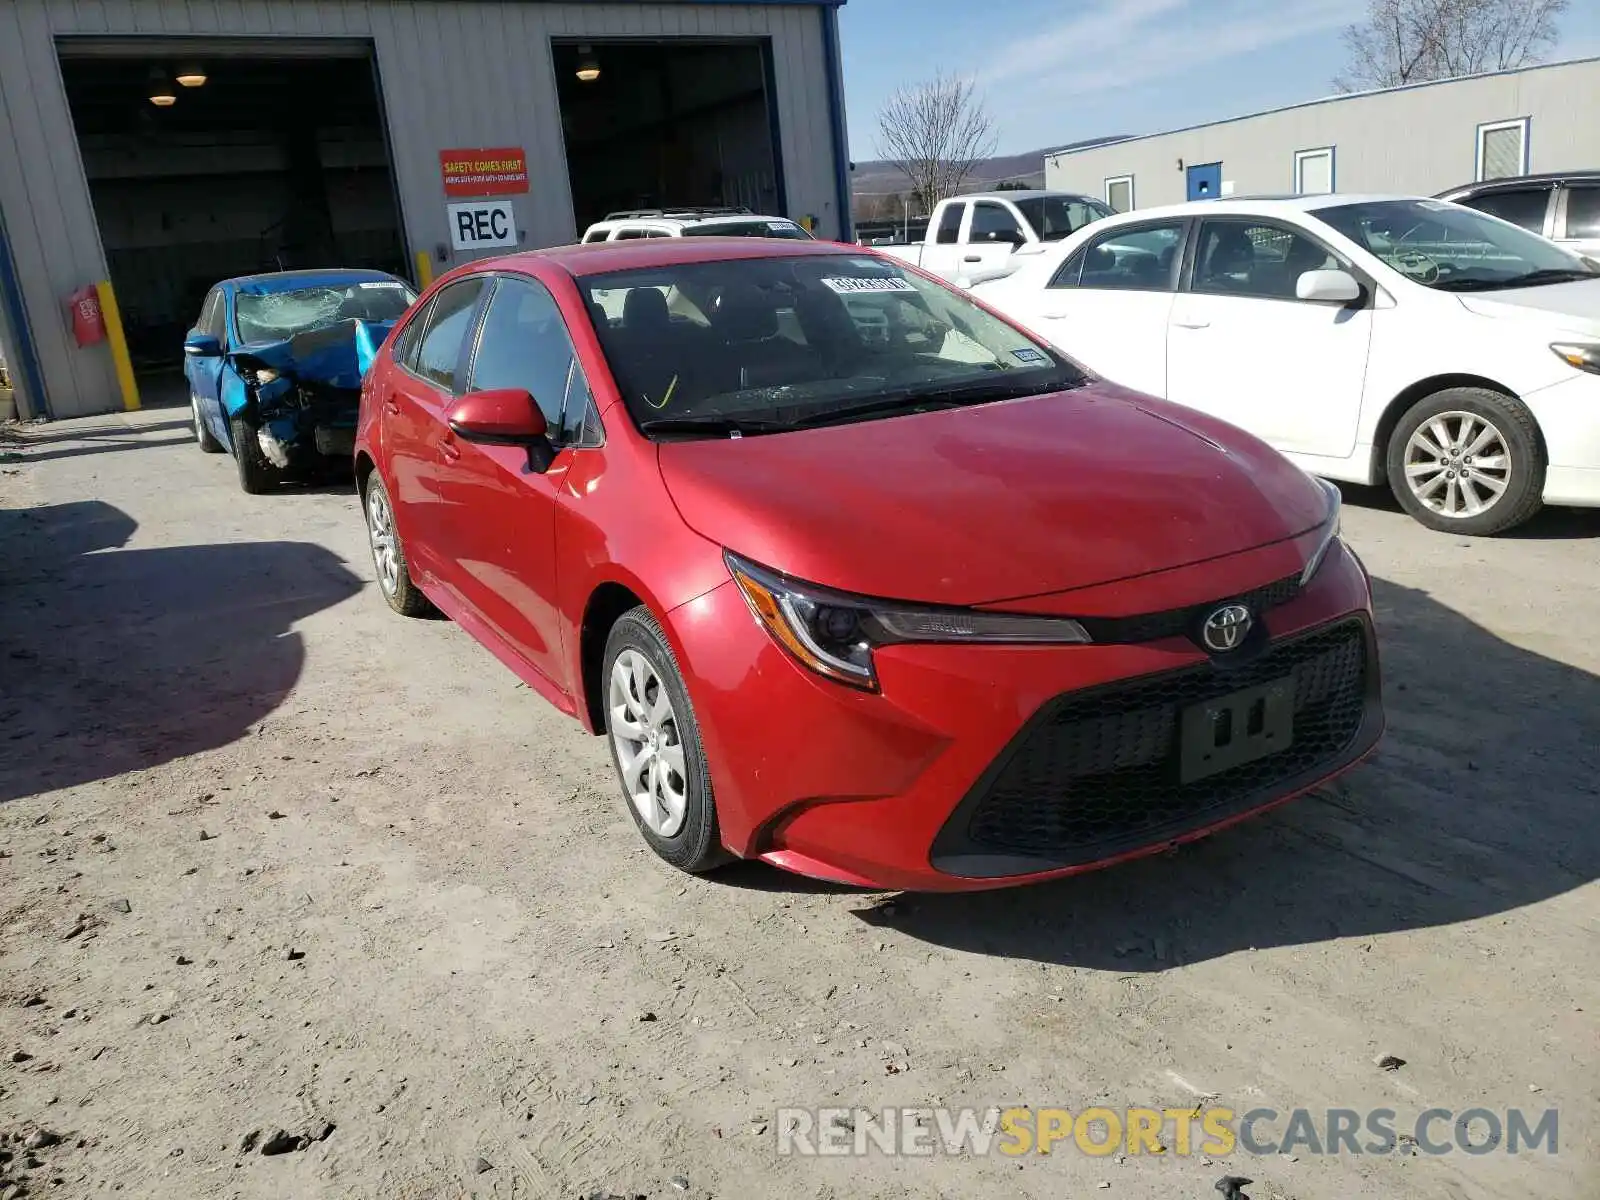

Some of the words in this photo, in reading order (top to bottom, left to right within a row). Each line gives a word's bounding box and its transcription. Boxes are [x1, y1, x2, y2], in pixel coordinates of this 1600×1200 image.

[444, 161, 473, 173] SAFETY
[475, 160, 500, 172] COMES
[502, 159, 522, 171] FIRST
[457, 209, 508, 241] REC
